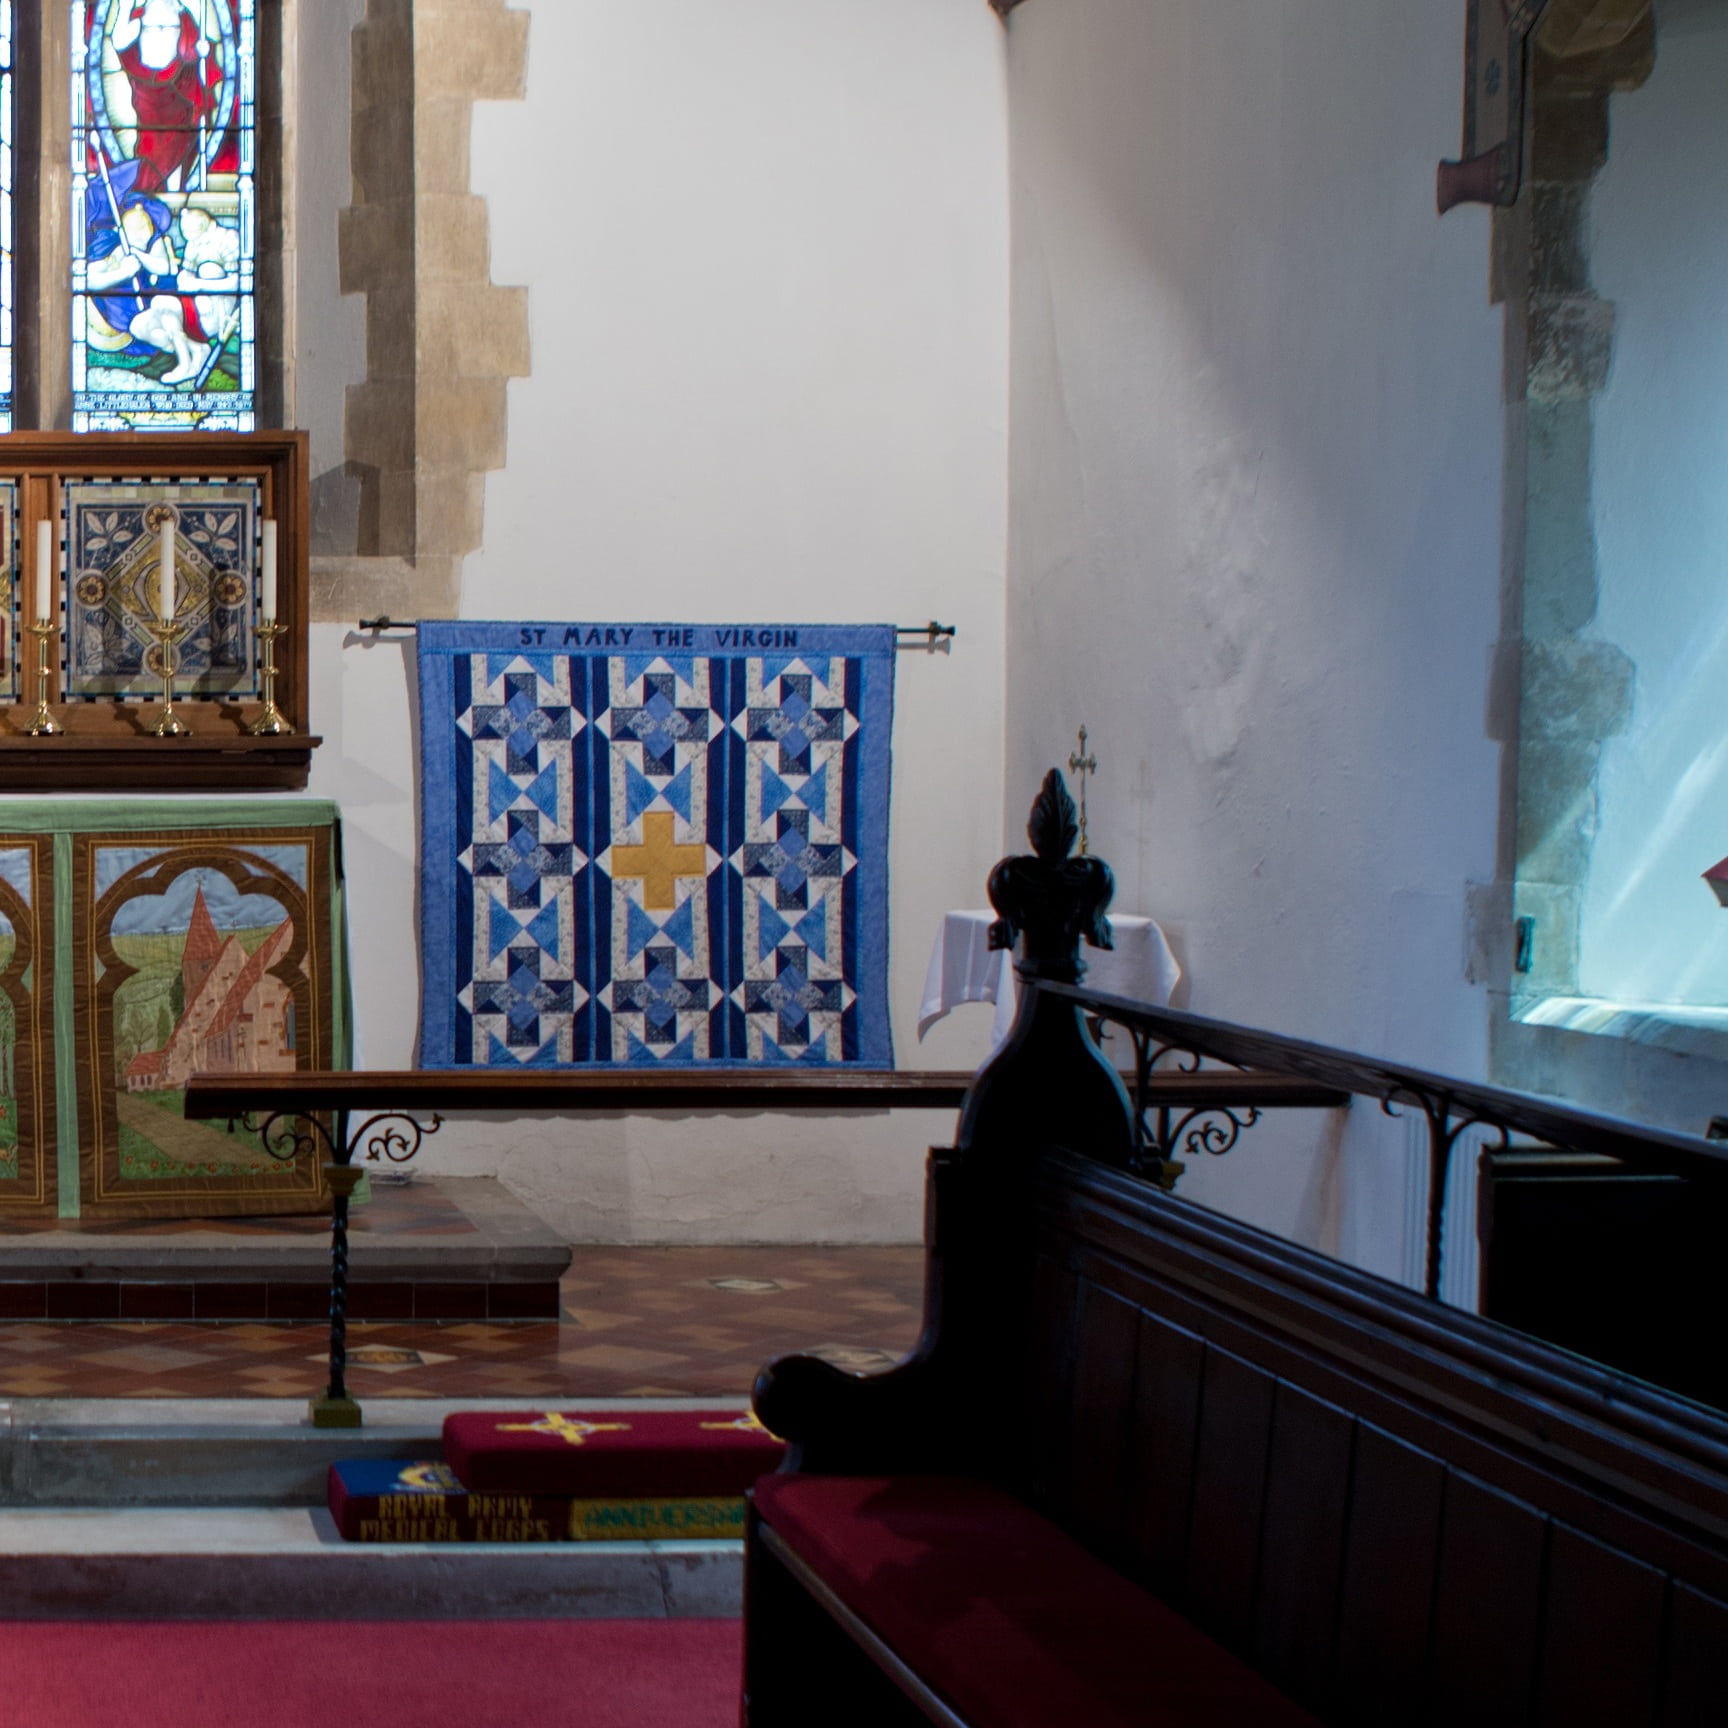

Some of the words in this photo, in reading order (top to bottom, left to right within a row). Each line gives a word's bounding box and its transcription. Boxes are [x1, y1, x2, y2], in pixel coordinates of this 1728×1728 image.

[519, 627, 547, 647] ST
[562, 627, 634, 647] MARY
[652, 628, 695, 648] THE
[715, 628, 800, 648] VIRGIN
